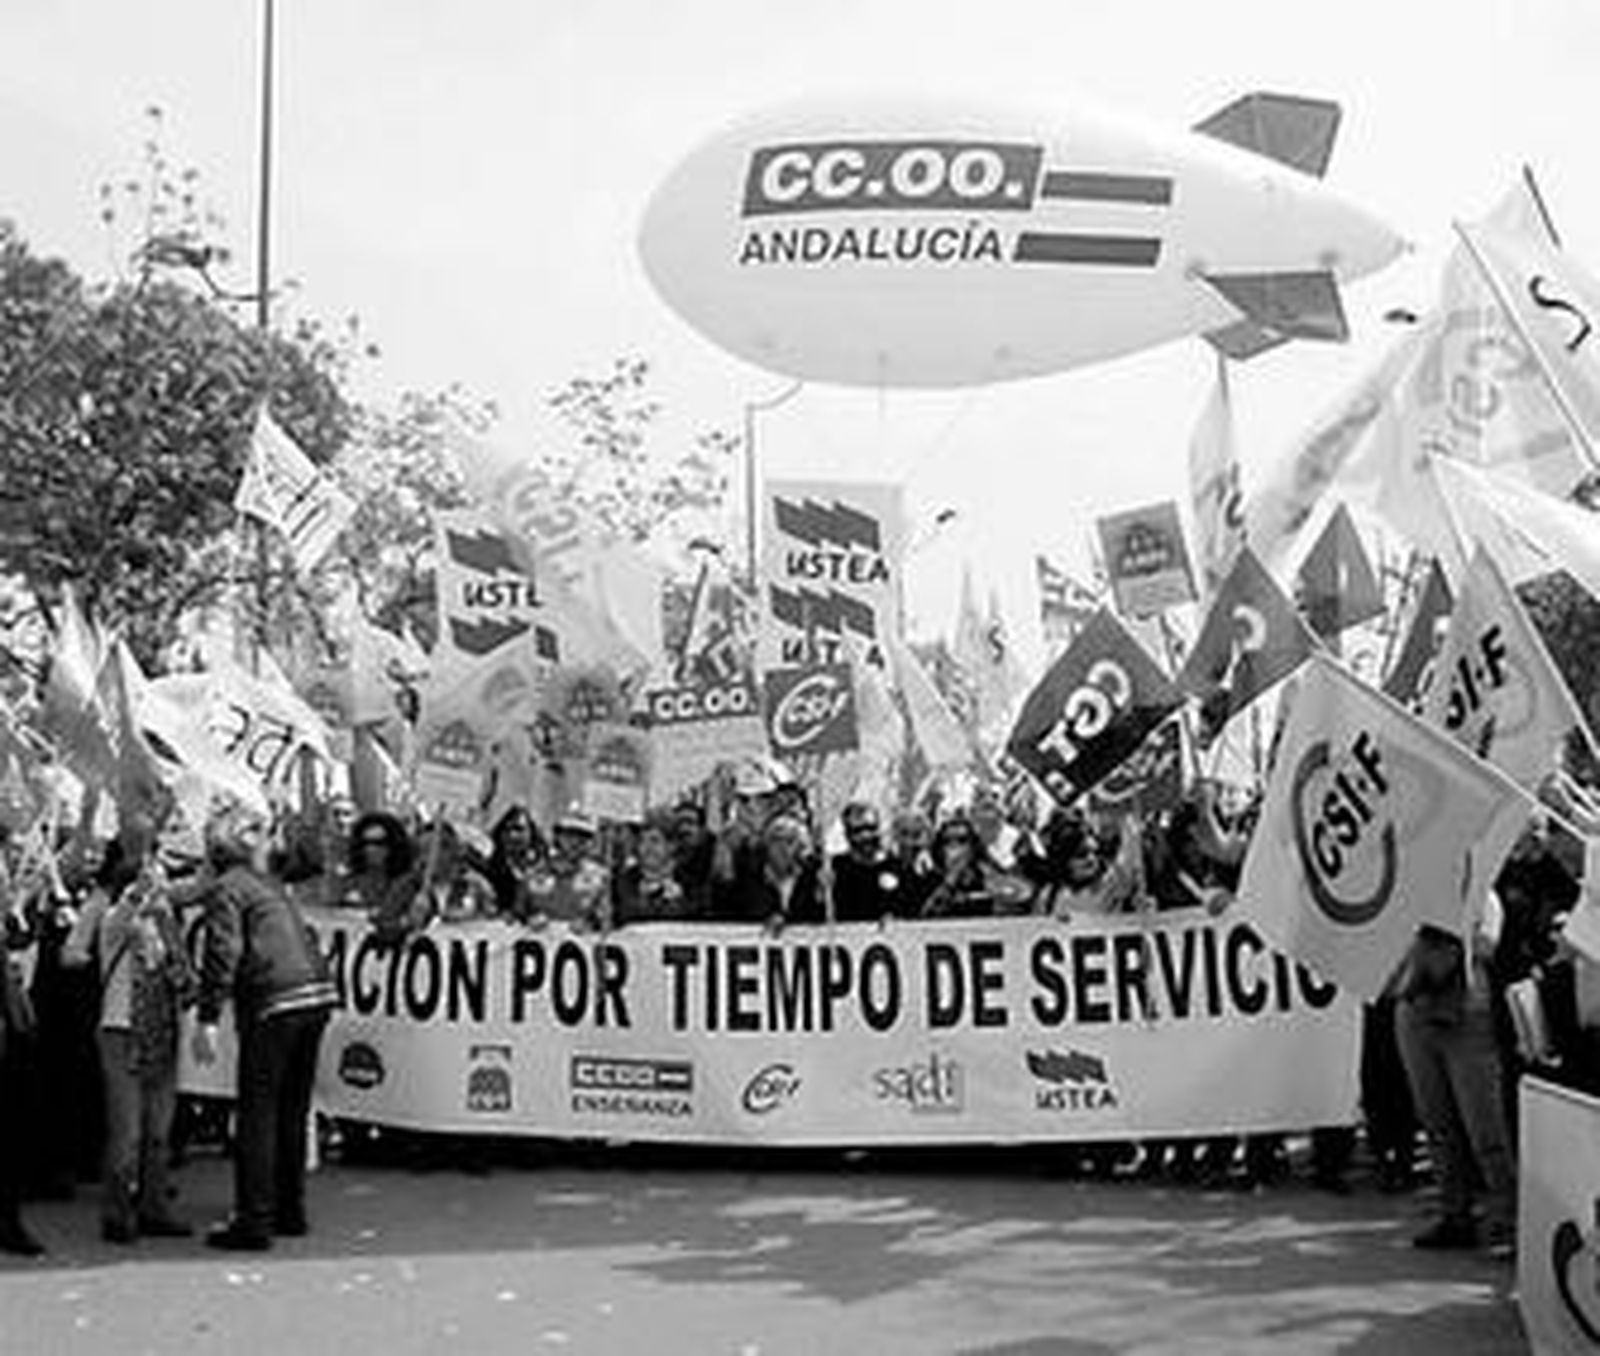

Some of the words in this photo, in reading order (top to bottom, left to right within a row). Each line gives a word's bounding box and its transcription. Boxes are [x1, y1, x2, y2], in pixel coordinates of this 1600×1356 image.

[761, 147, 1023, 201] CC.OO.
[740, 221, 1002, 265] ANDALUCÍA
[786, 550, 889, 583] USTEA
[511, 938, 630, 1028] POR
[662, 942, 901, 1033] TIEMPO
[924, 940, 1009, 1029] DE
